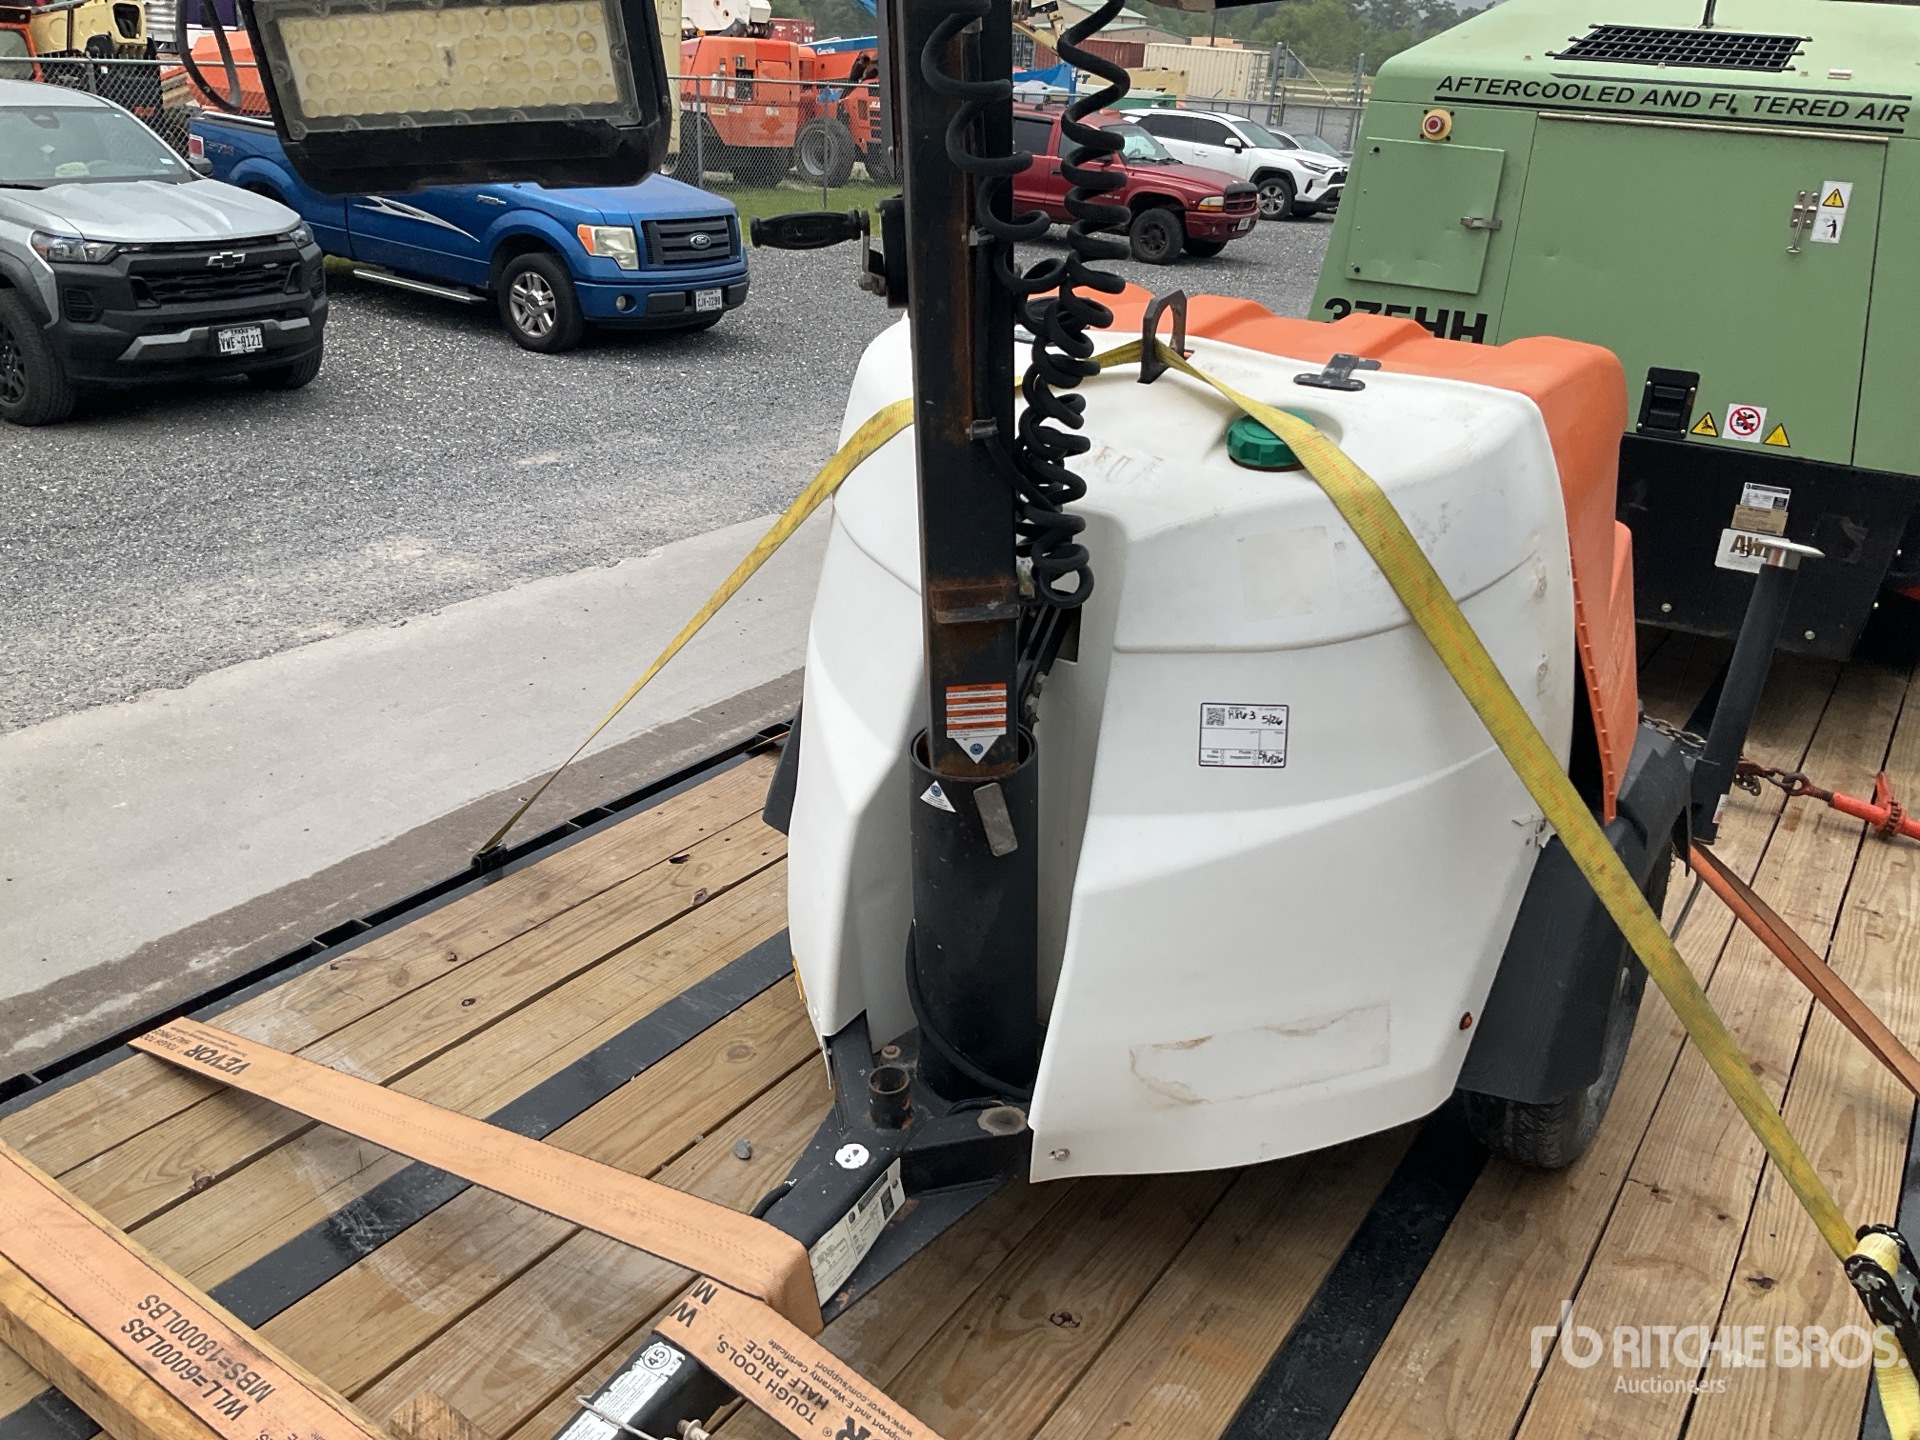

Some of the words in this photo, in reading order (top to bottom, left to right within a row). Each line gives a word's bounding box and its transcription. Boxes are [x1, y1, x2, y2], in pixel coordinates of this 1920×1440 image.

[1436, 75, 1635, 104] AFTERCOOLED
[1640, 89, 1702, 109] AND
[1708, 92, 1850, 118] FITERED
[1854, 102, 1911, 123] AIR
[183, 1044, 251, 1076] VEVOR
[137, 1294, 277, 1404] MBS=18000LBS
[646, 1349, 666, 1366] 45
[716, 1333, 765, 1385] TOOLS,
[743, 1339, 789, 1380] PRICE
[768, 1338, 808, 1374] Certificate
[120, 1318, 249, 1422] WLL=6000LBS
[809, 1369, 855, 1409] E-Warranty
[765, 1378, 817, 1426] TOUGH
[788, 1377, 829, 1411] HALF
[814, 1360, 913, 1438] www.vevor.com/support
[854, 1404, 873, 1420] and
